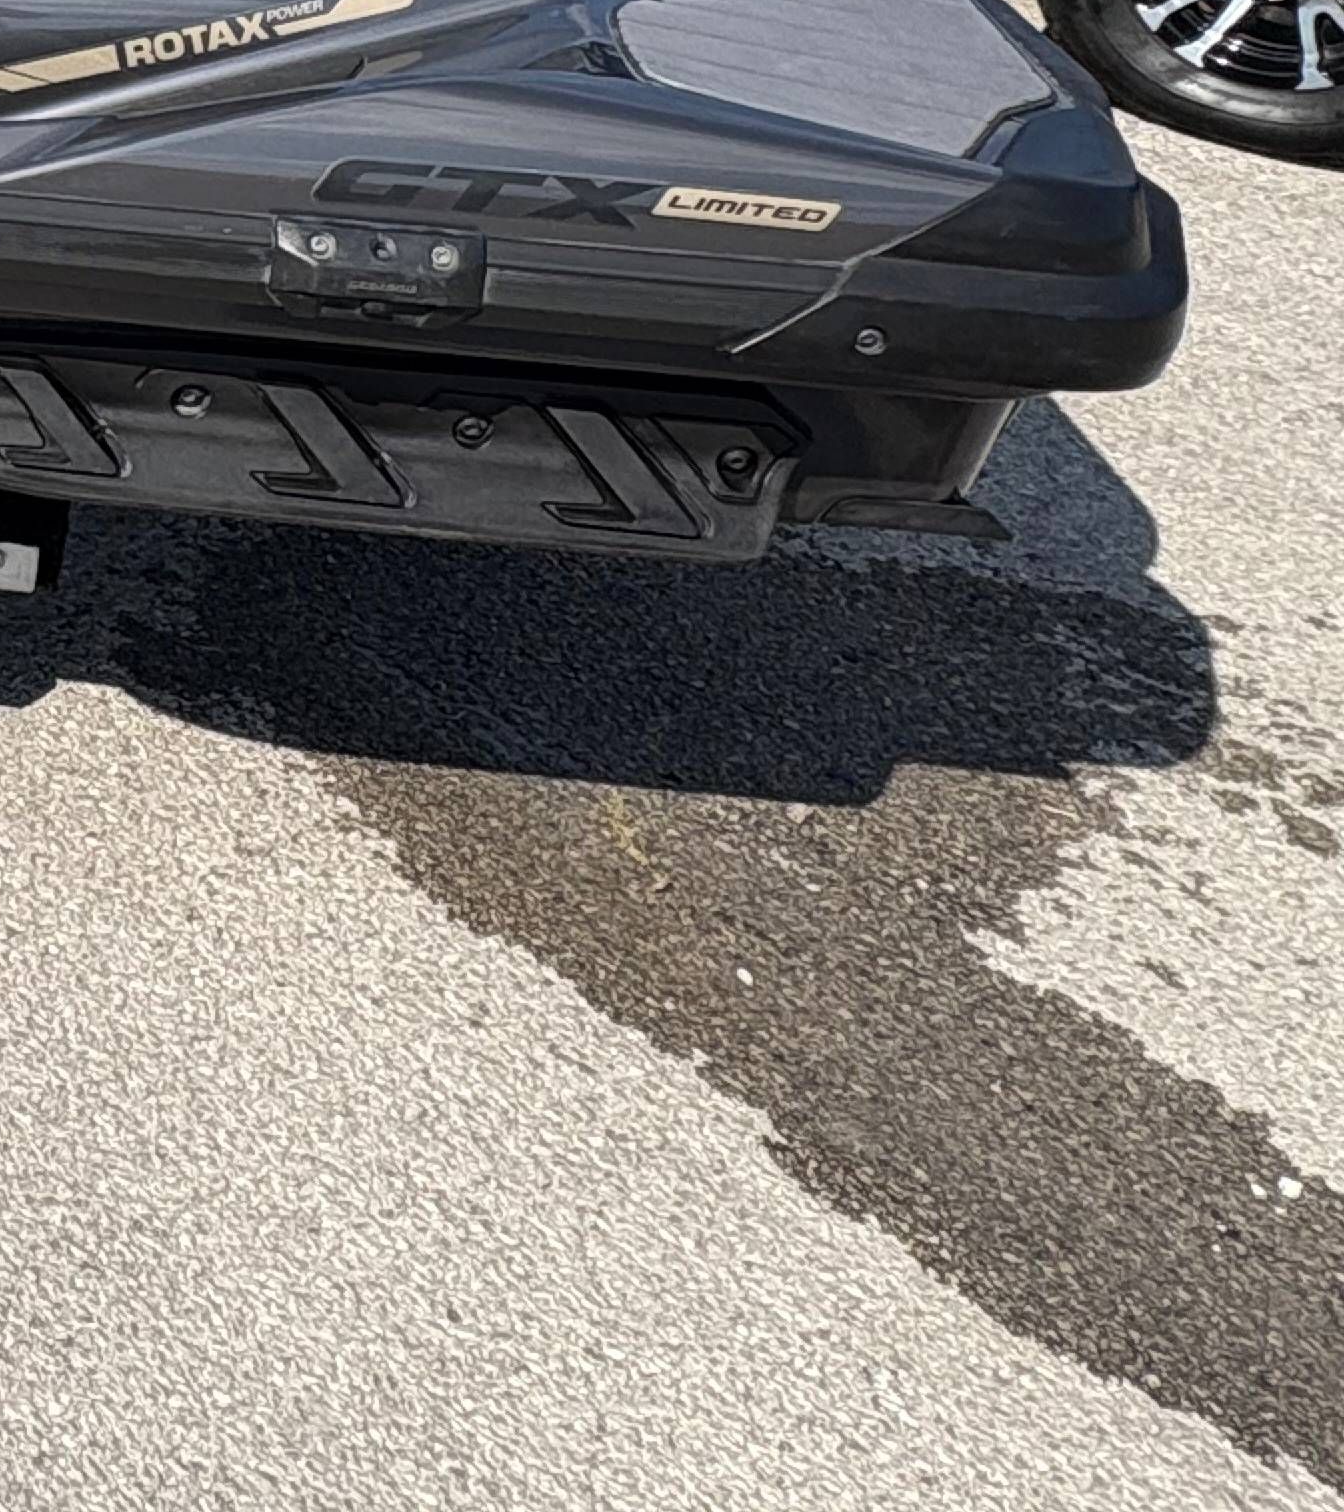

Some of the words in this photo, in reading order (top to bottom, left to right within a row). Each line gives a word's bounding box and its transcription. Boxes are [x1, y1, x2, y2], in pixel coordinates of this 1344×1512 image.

[124, 12, 270, 68] ROTAX
[313, 159, 664, 230] GTX
[668, 194, 828, 224] LIMITED
